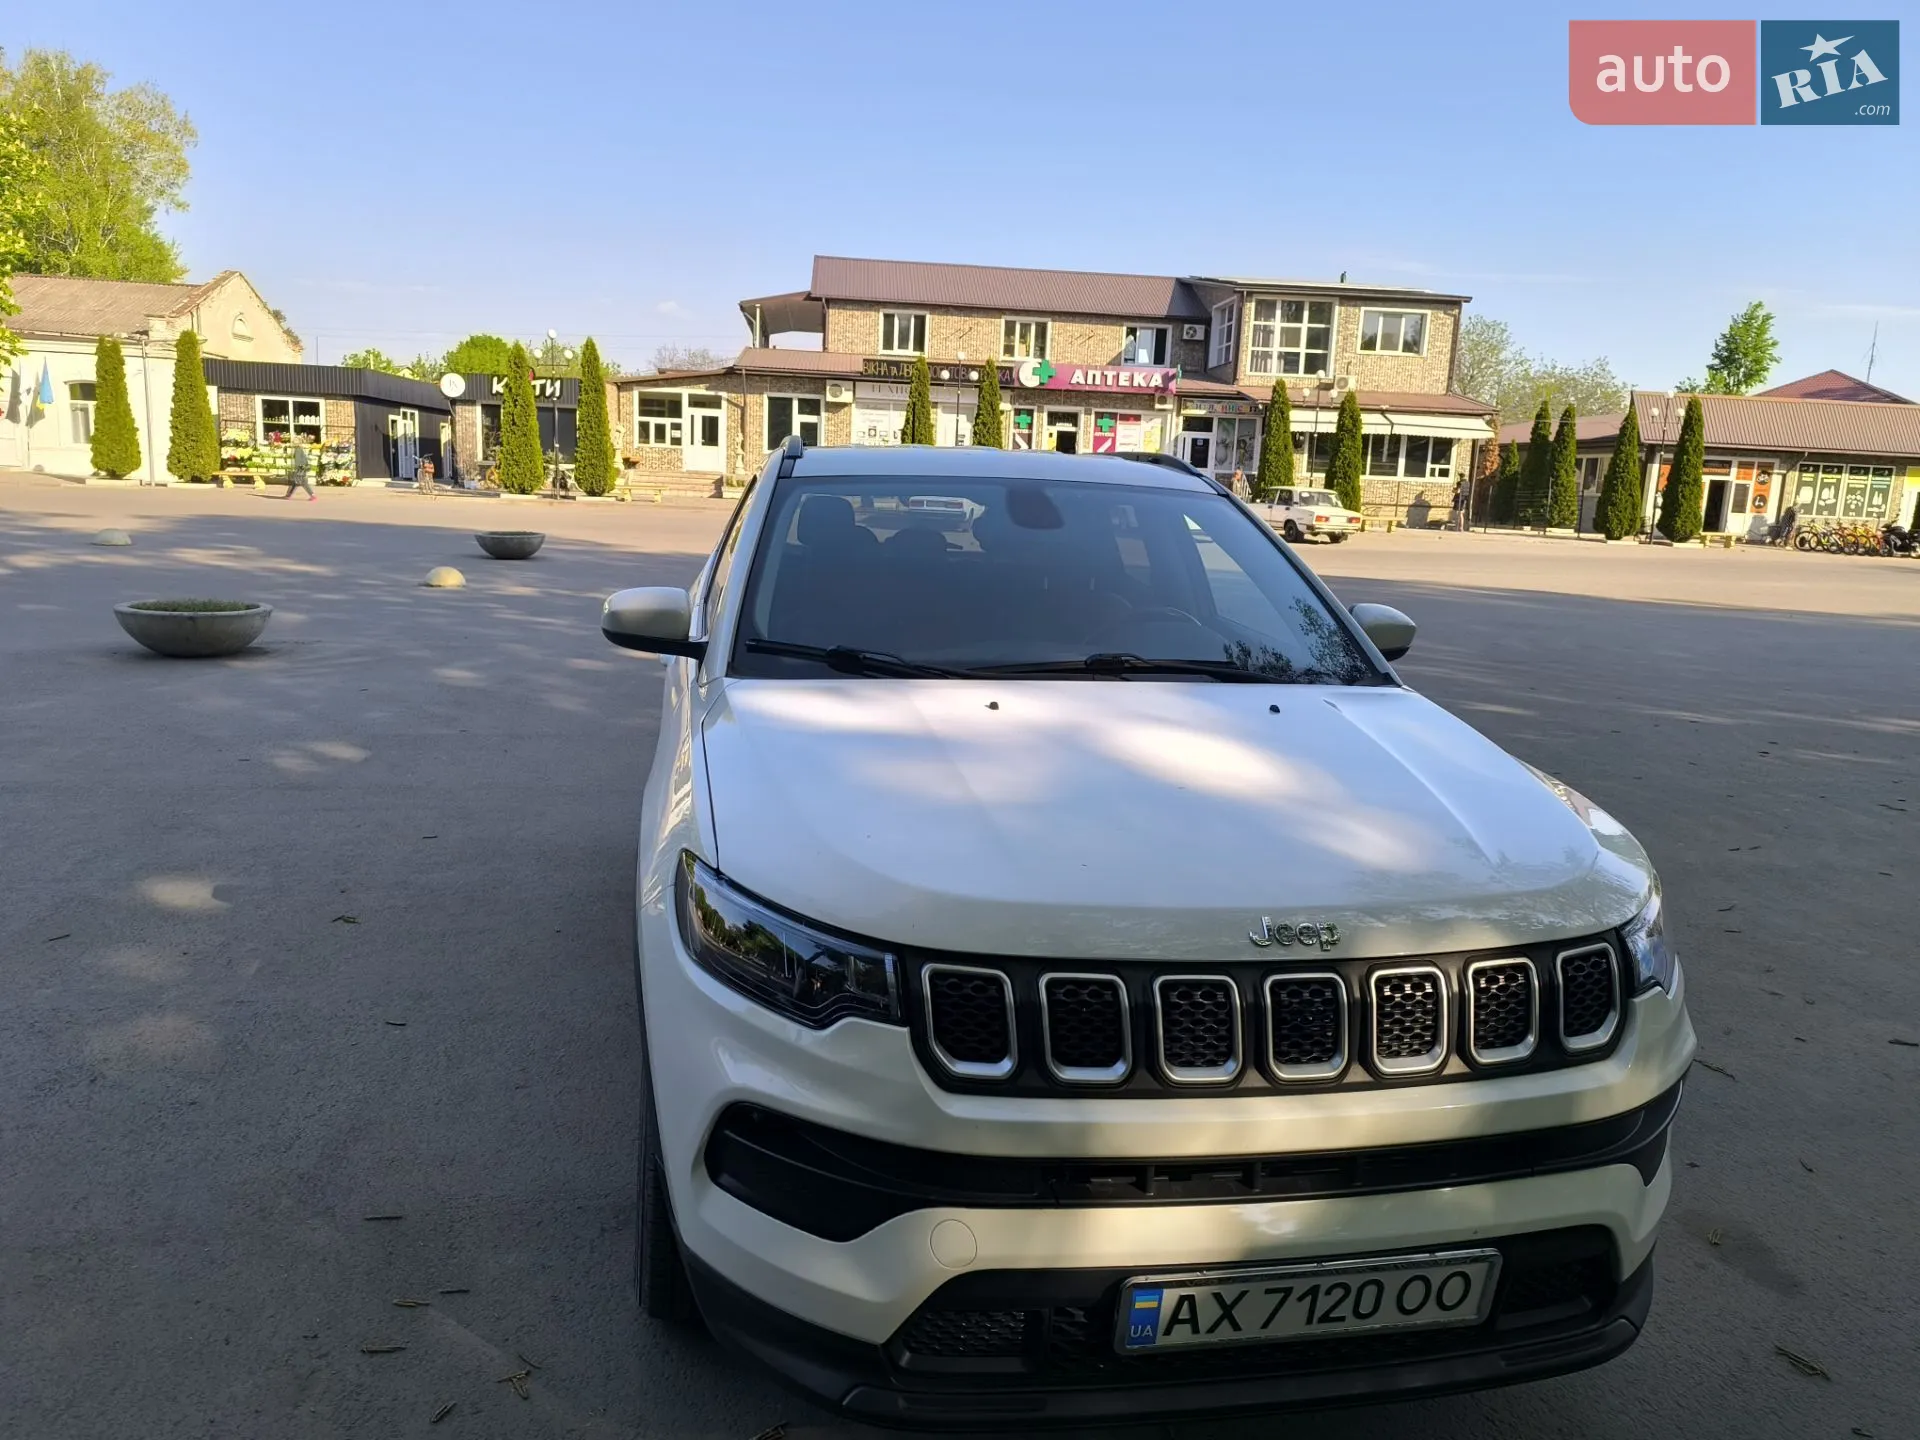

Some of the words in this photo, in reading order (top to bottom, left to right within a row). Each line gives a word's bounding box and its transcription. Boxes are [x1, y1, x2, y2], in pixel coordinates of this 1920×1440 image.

[492, 376, 561, 398] КТИ
[1070, 368, 1164, 388] АПТЕКА
[1249, 915, 1341, 951] Jeep
[1162, 1290, 1250, 1336] AX
[1260, 1278, 1384, 1329] 7120
[1130, 1324, 1153, 1338] UA
